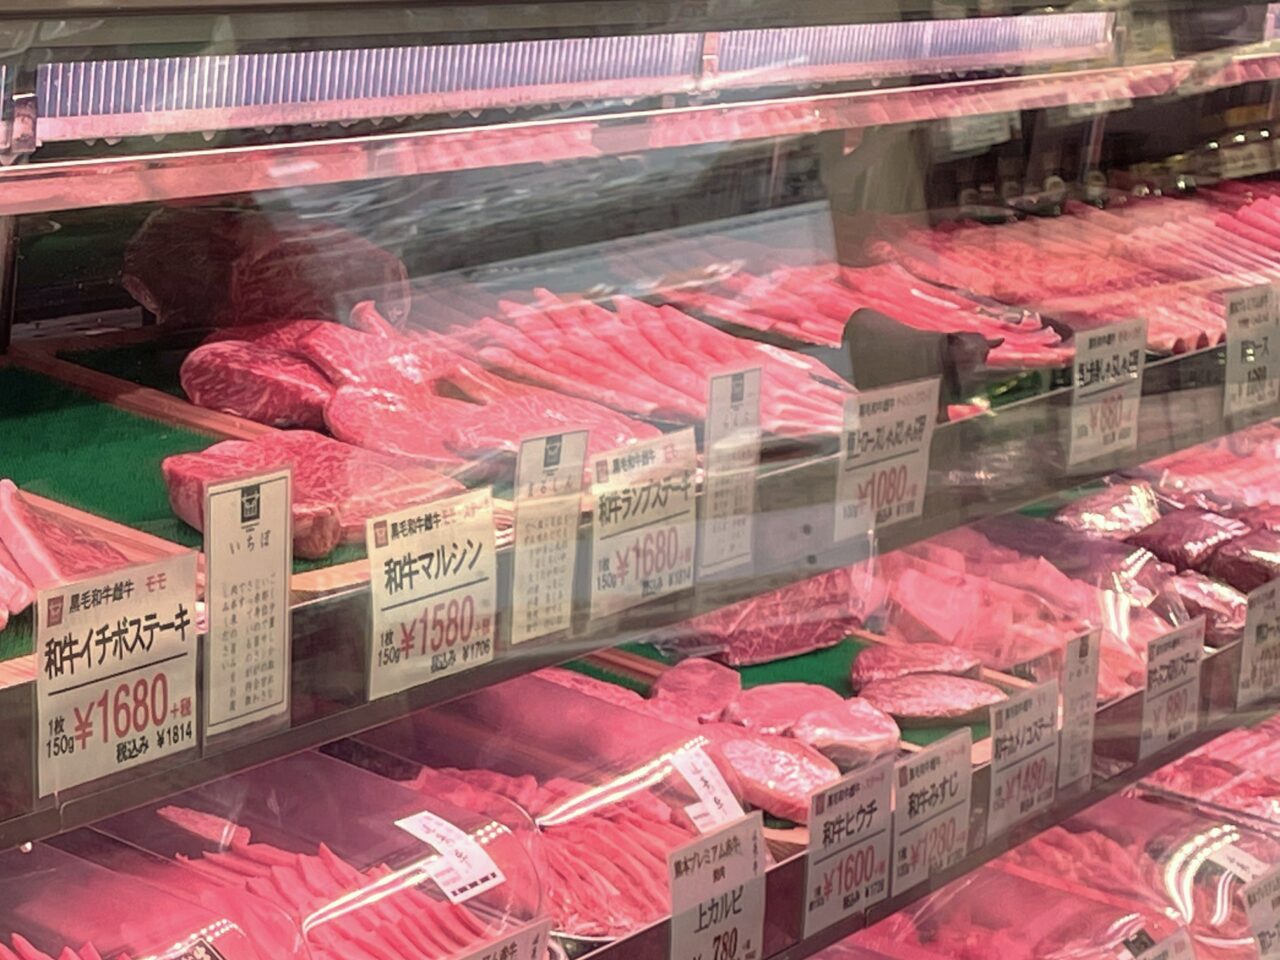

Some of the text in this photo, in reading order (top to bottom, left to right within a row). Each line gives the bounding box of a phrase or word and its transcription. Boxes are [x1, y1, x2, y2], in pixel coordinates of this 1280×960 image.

[598, 470, 691, 526] 和牛ランプステーキ
[384, 540, 483, 595] 和牛マルシン
[616, 527, 678, 584] ¥1680
[69, 573, 166, 613] 黒毛和牛雌牛 モモ
[45, 604, 190, 680] 和牛イチボステーキ
[400, 595, 474, 659] ¥1580
[46, 736, 74, 758] 150g
[74, 673, 168, 749] ¥1680
[117, 721, 192, 763] 税込み ¥1814
[824, 845, 875, 899] ¥1600
[694, 885, 744, 933] 上カルビ
